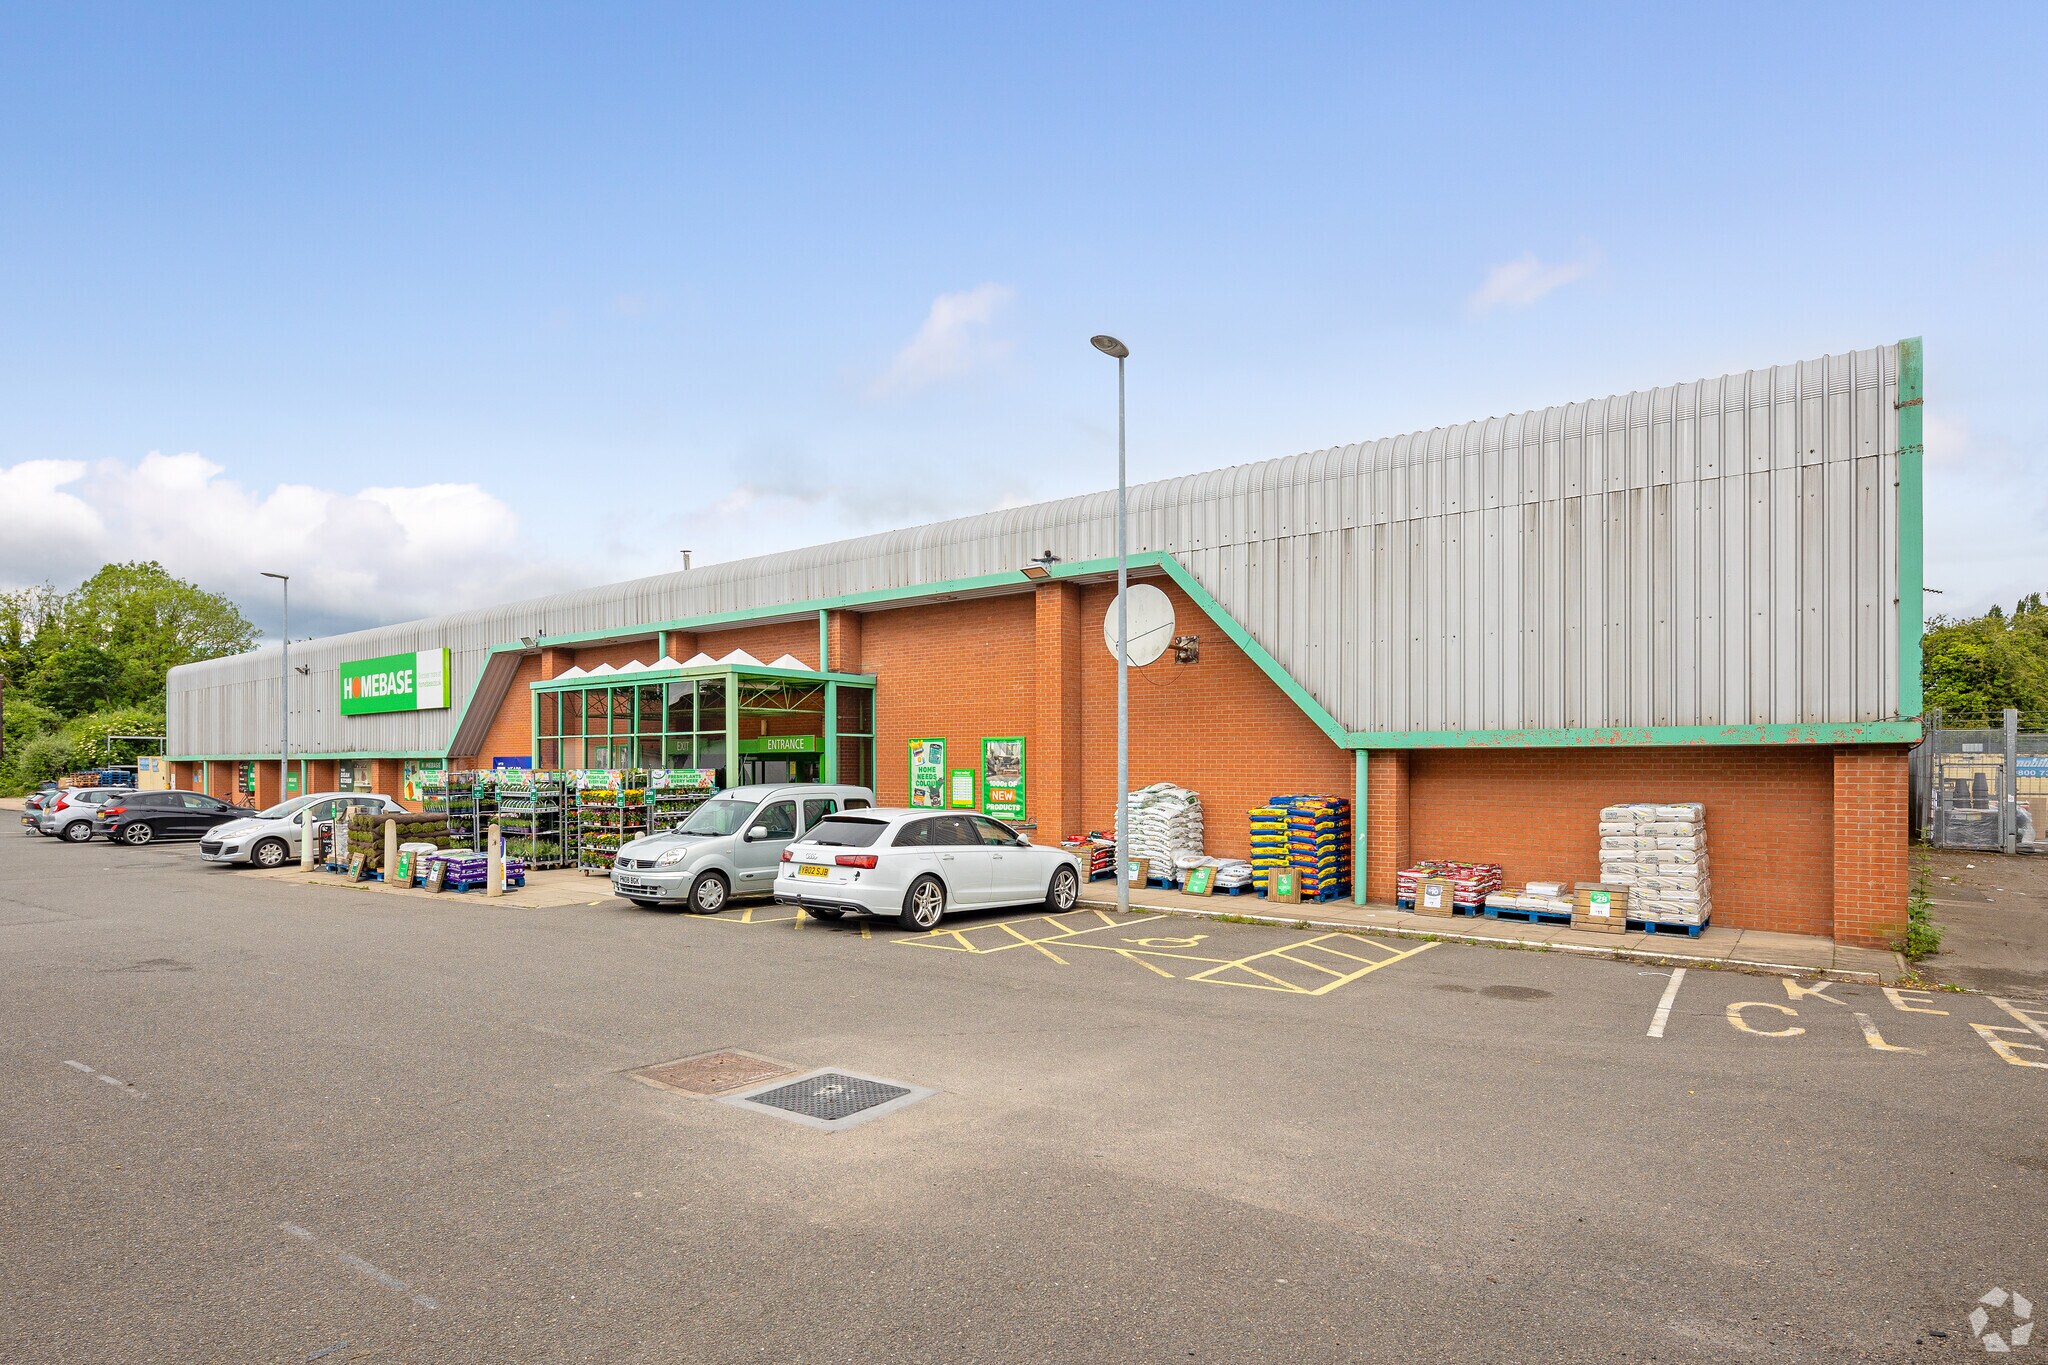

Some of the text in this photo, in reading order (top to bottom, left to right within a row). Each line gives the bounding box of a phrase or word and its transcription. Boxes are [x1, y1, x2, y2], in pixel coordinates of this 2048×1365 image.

[343, 669, 413, 700] HOMEBASE
[676, 741, 690, 751] EXIT
[767, 738, 804, 750] ENTRANCE
[992, 791, 1013, 801] NEW
[986, 803, 1021, 811] PRODUCTS
[801, 866, 829, 876] YB02 SJB
[1593, 895, 1608, 903] £28
